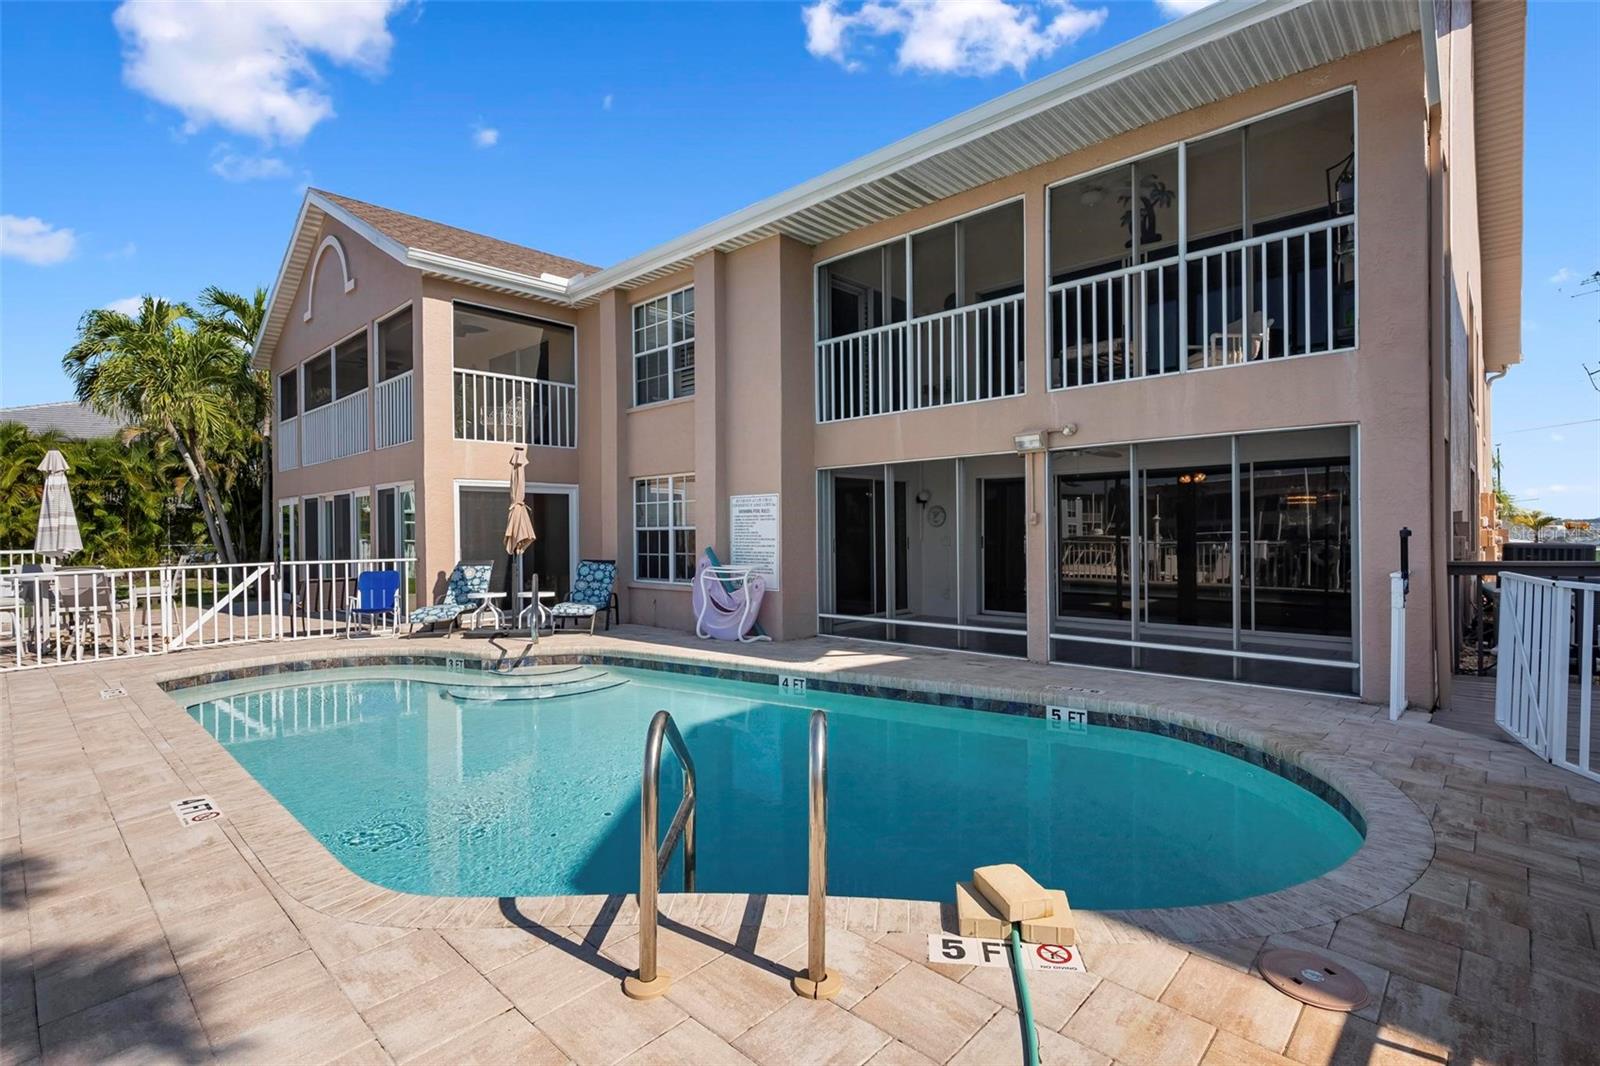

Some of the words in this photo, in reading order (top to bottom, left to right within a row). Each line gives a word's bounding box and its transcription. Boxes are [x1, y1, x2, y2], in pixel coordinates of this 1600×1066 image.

[455, 659, 464, 668] FT
[782, 678, 789, 686] 4
[793, 678, 804, 688] FT
[1052, 709, 1061, 720] 5
[1068, 711, 1085, 723] FT
[942, 939, 966, 960] 5
